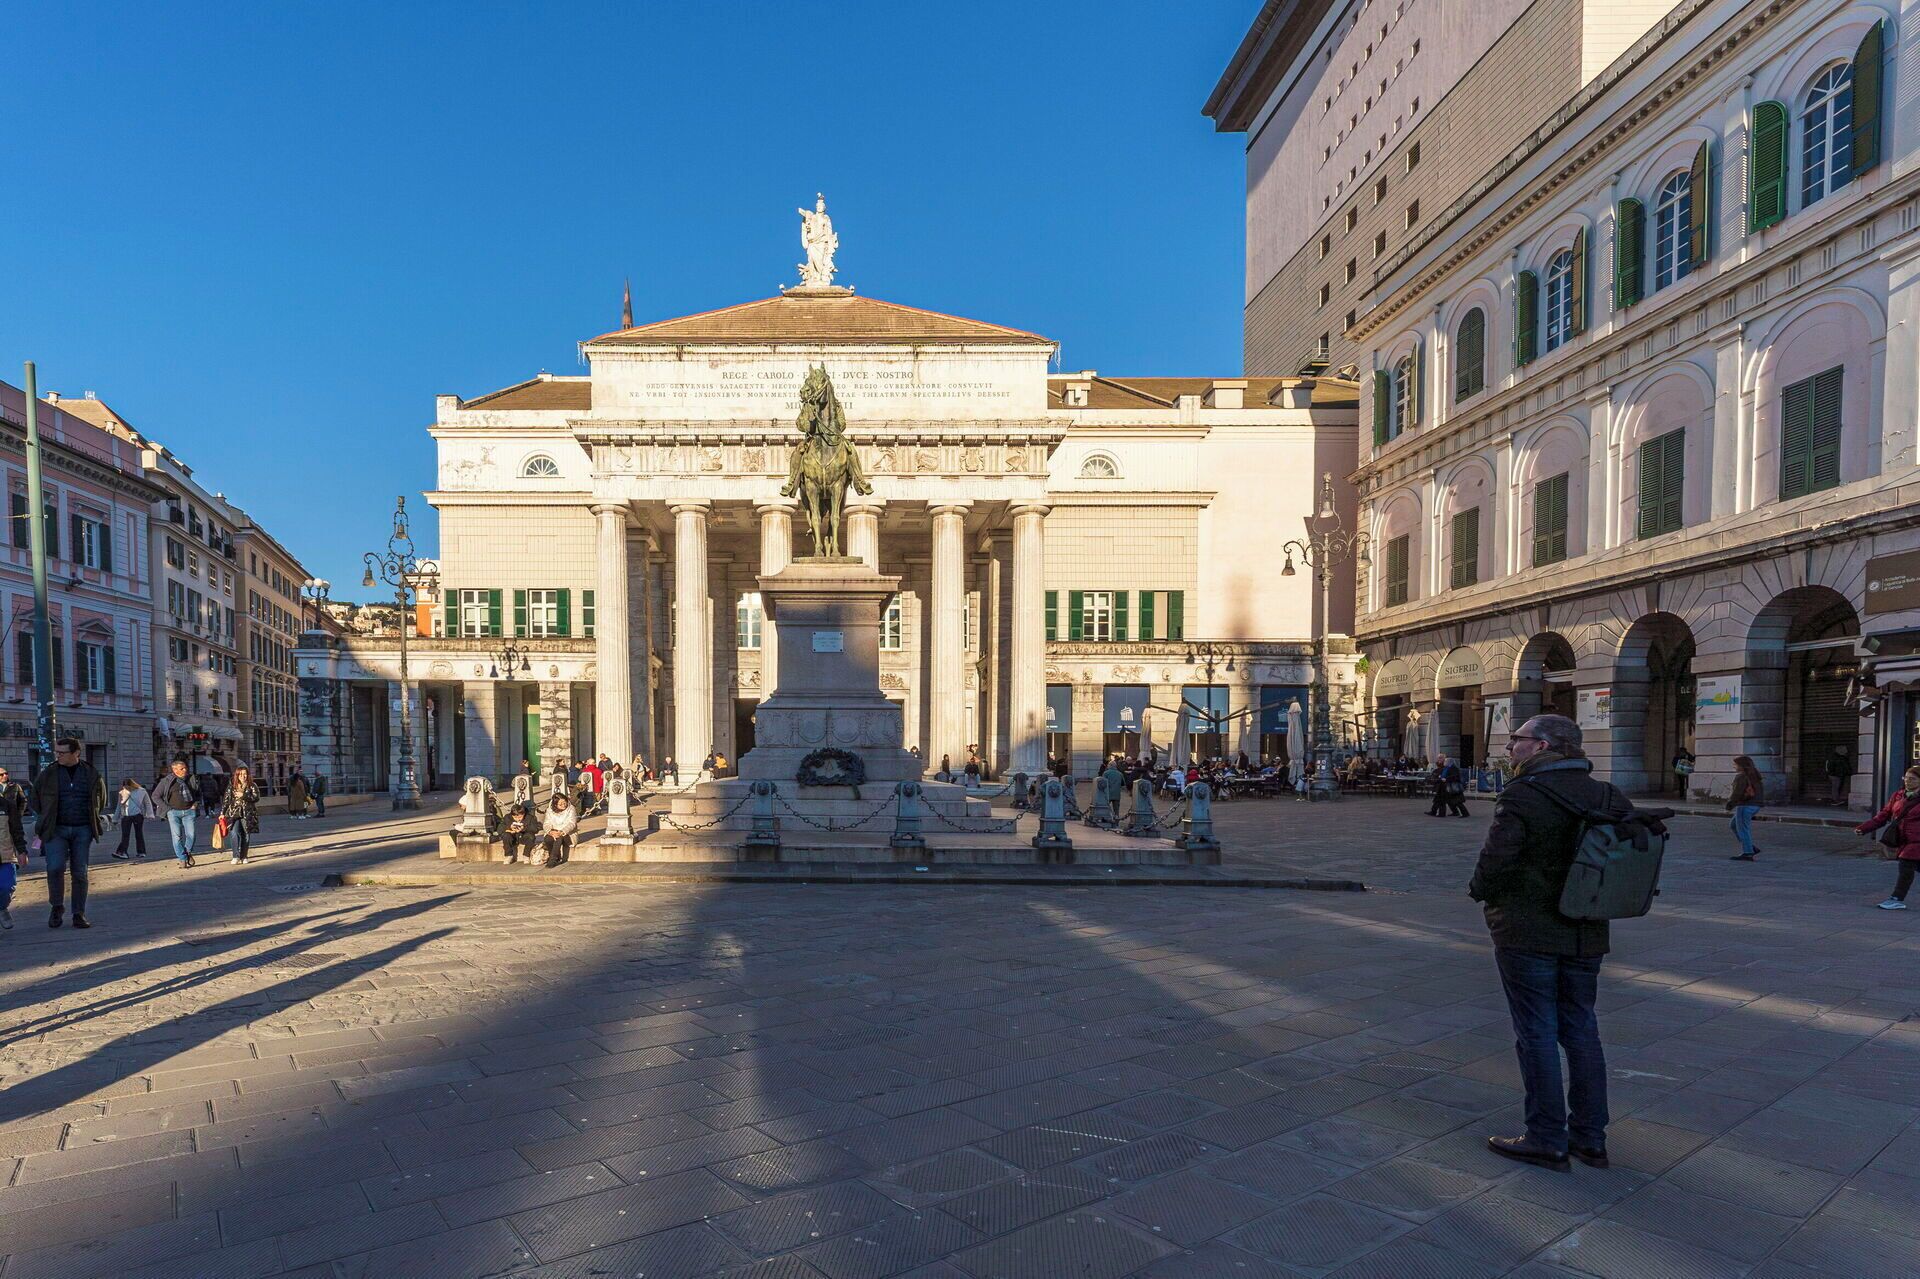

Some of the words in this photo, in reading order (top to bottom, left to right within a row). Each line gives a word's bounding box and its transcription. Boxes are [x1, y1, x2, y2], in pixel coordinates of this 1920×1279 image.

[722, 372, 748, 380] REGE
[757, 372, 795, 380] CAROLO
[876, 371, 914, 379] NOSTRO
[1445, 663, 1479, 675] SIGFRID
[1381, 673, 1408, 684] SIGFRID
